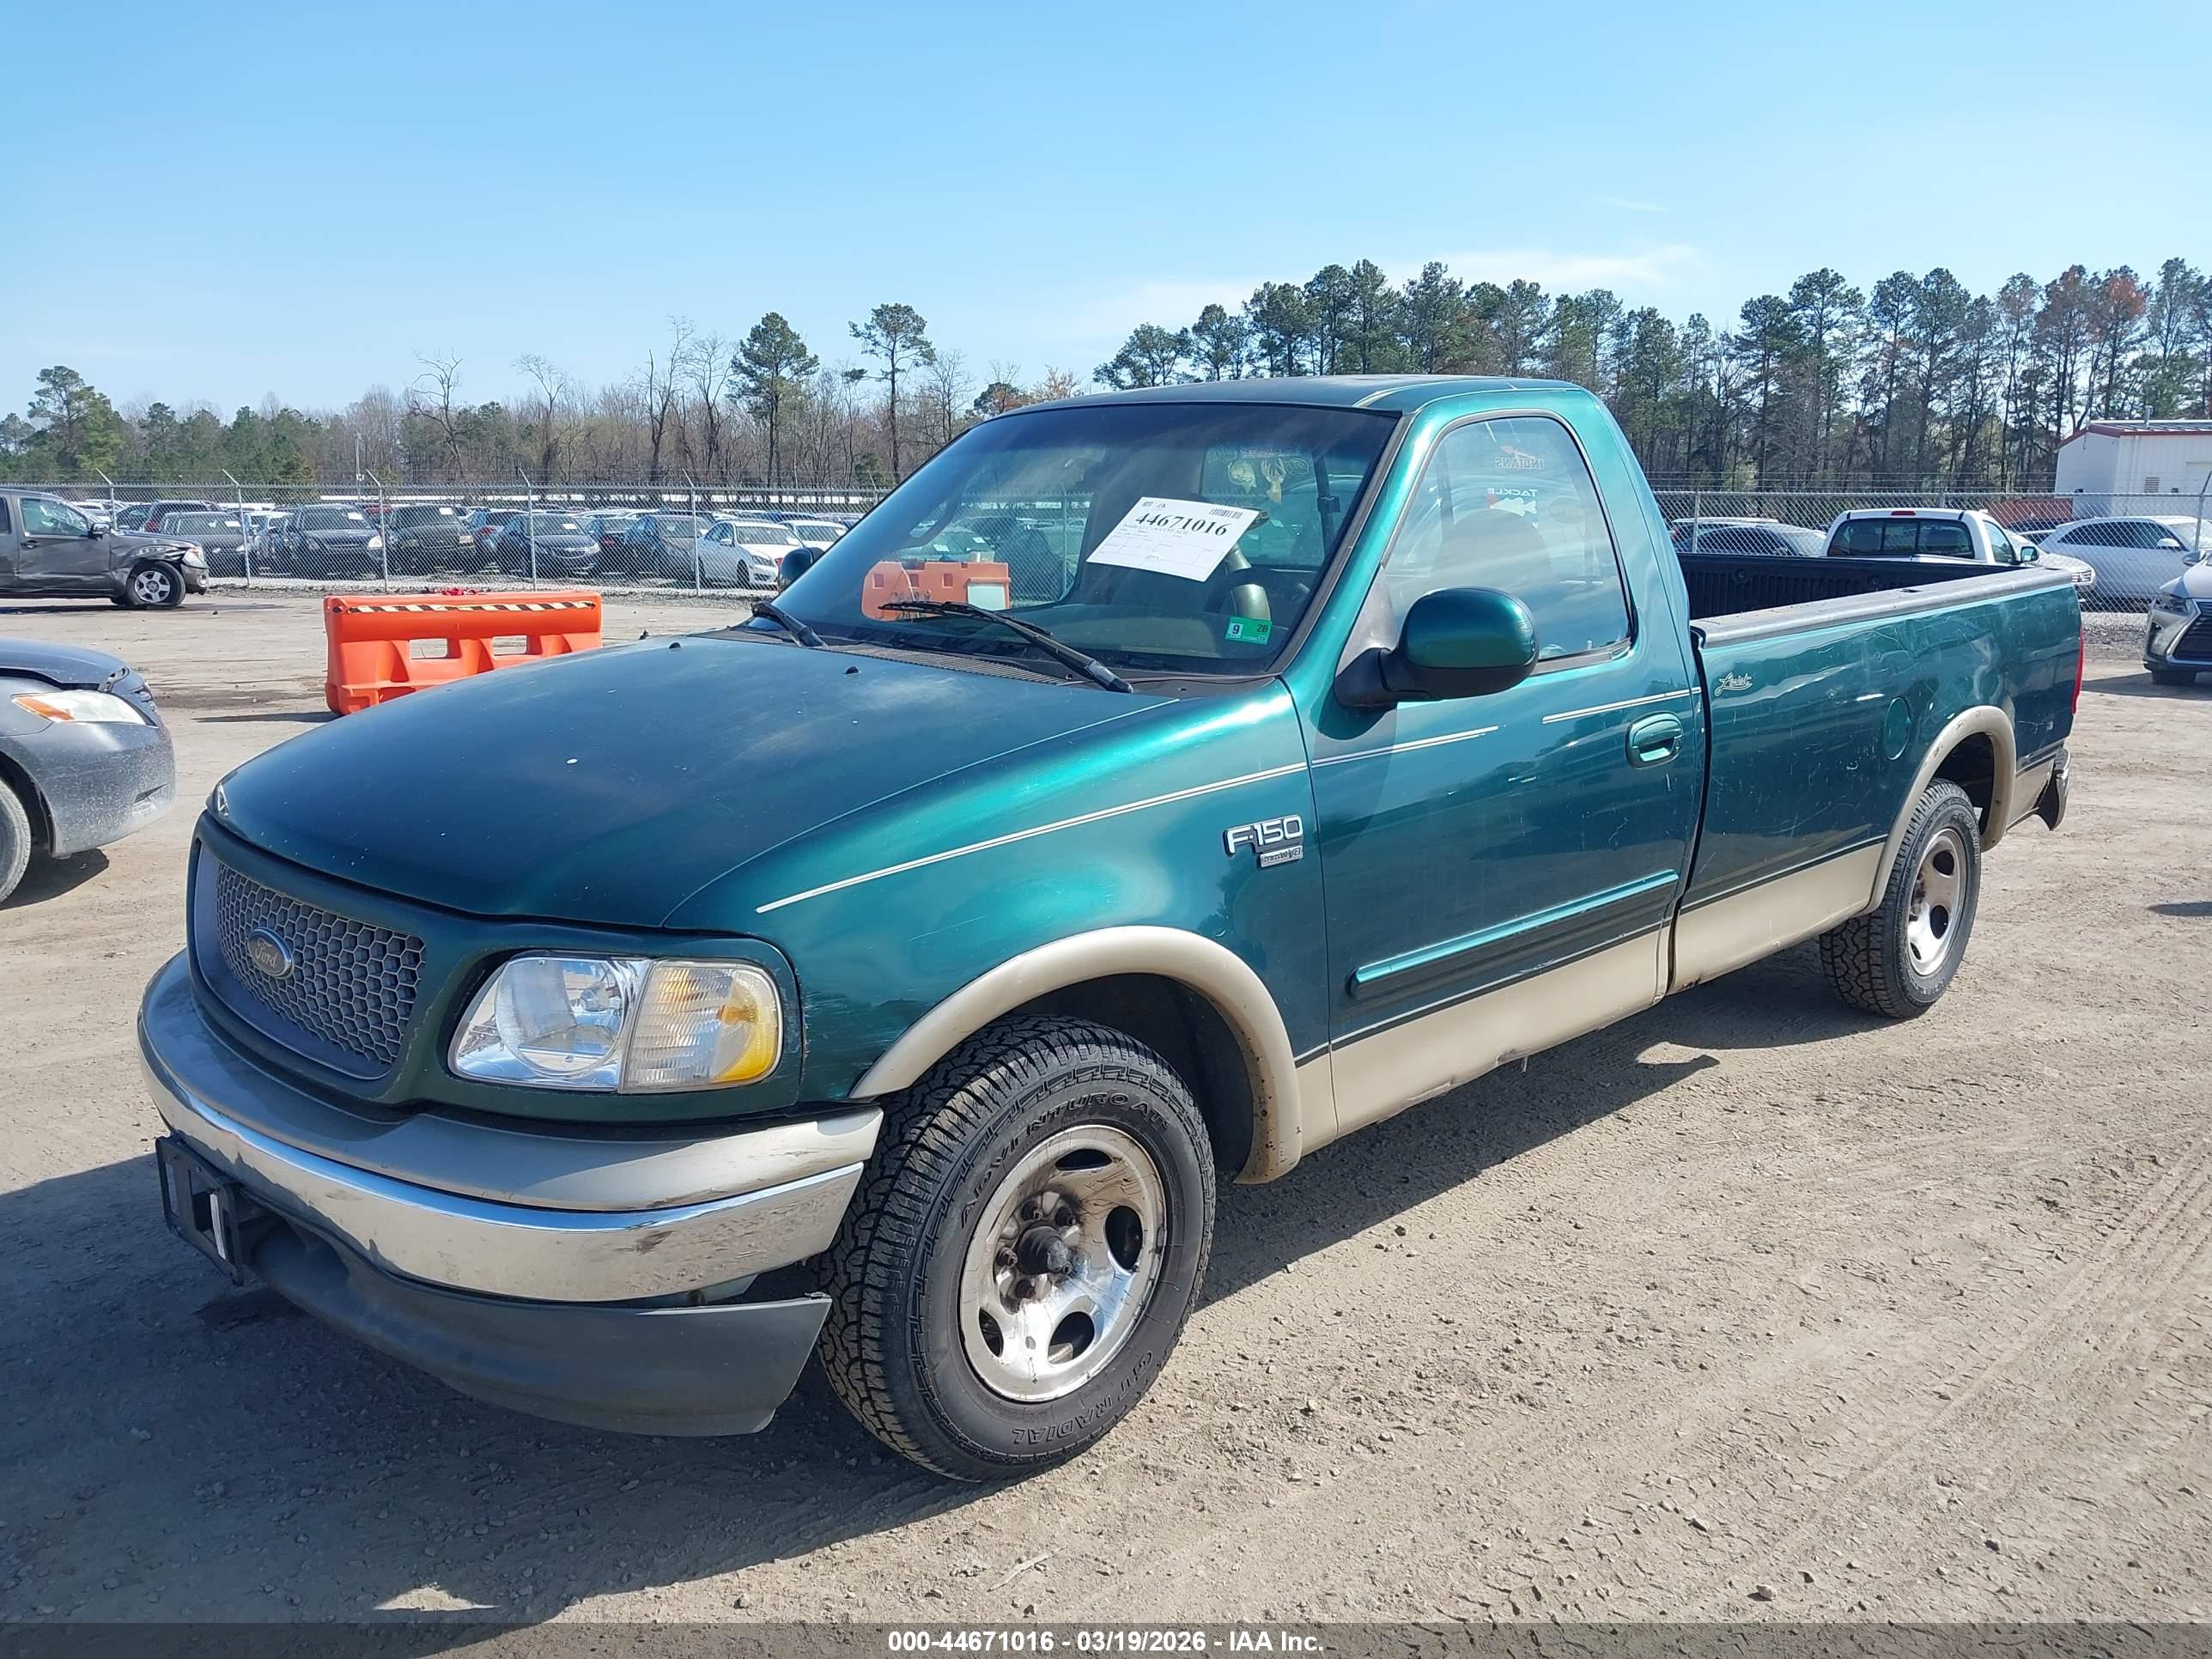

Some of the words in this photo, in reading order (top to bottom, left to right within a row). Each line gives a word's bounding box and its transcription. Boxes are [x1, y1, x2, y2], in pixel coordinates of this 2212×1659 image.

[1135, 513, 1234, 537] 44671016
[1232, 624, 1241, 635] 9
[255, 937, 277, 969] Ford
[1012, 1394, 1114, 1445] RADIAL
